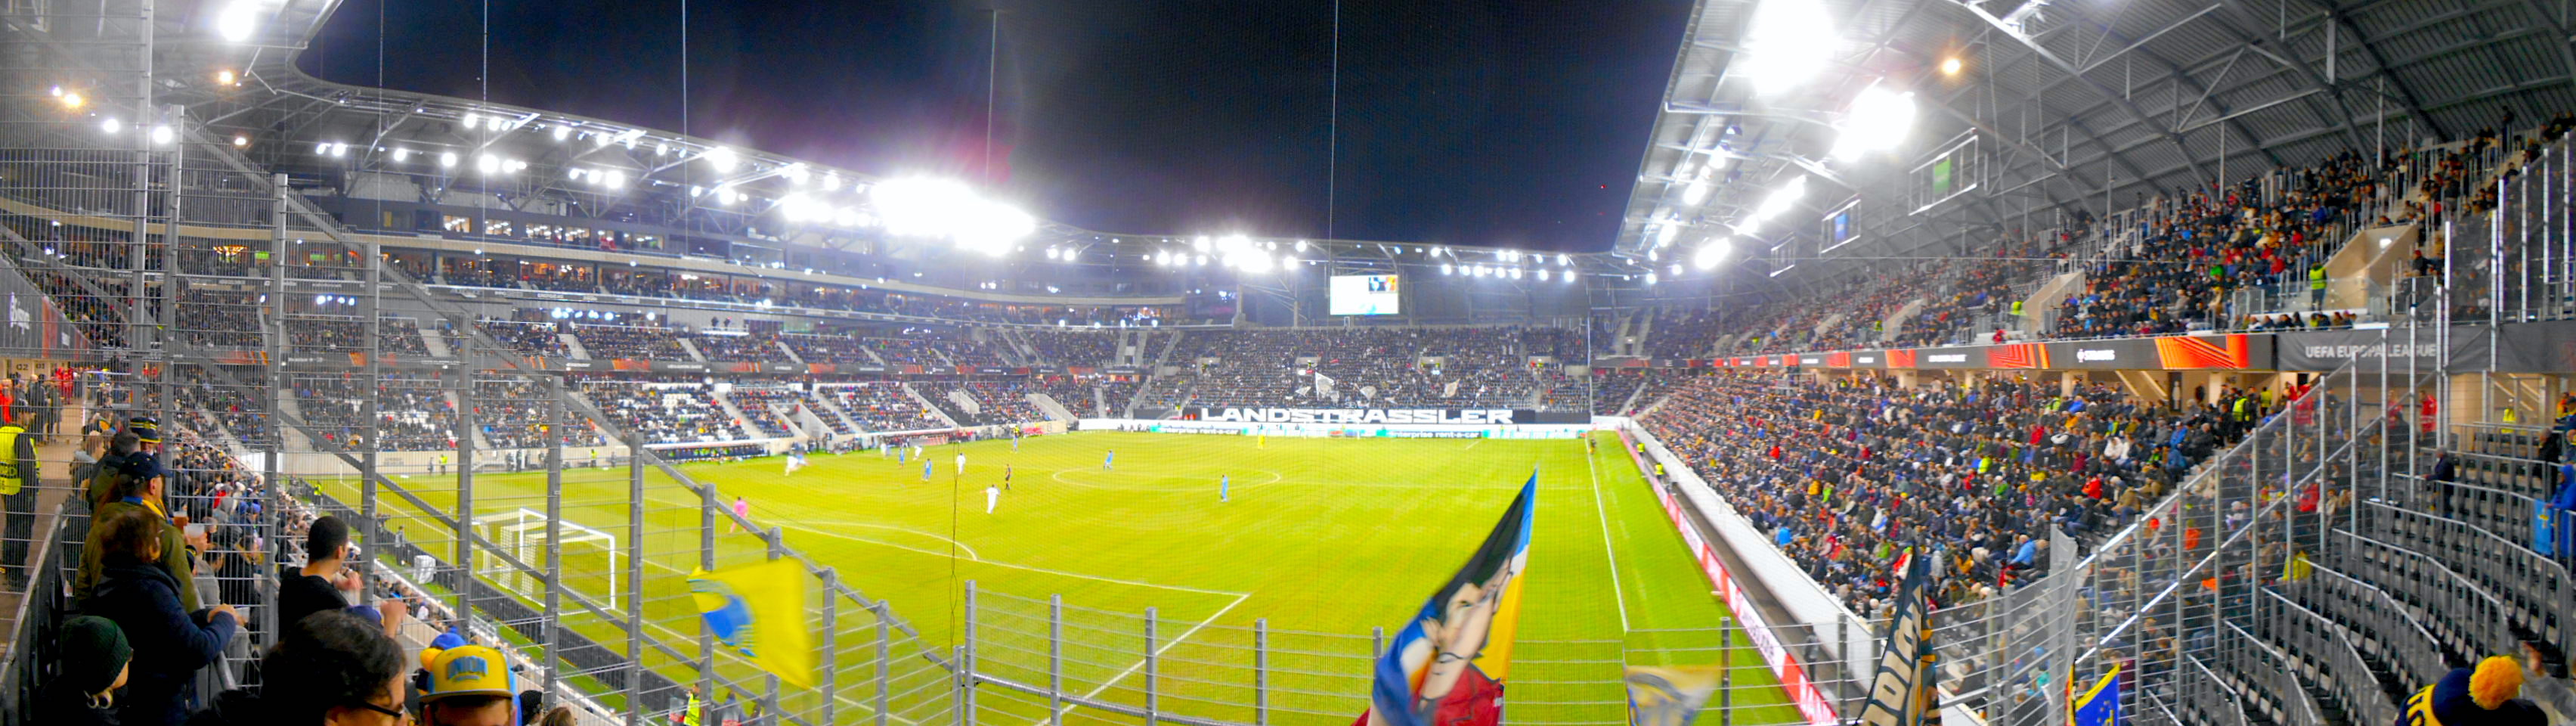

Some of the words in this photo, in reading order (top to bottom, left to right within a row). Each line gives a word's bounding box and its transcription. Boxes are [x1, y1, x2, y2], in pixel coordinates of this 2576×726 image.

[2305, 346, 2334, 358] UEFA
[2386, 343, 2436, 358] LEAUE
[1201, 408, 1513, 424] LANDSTRASSLER
